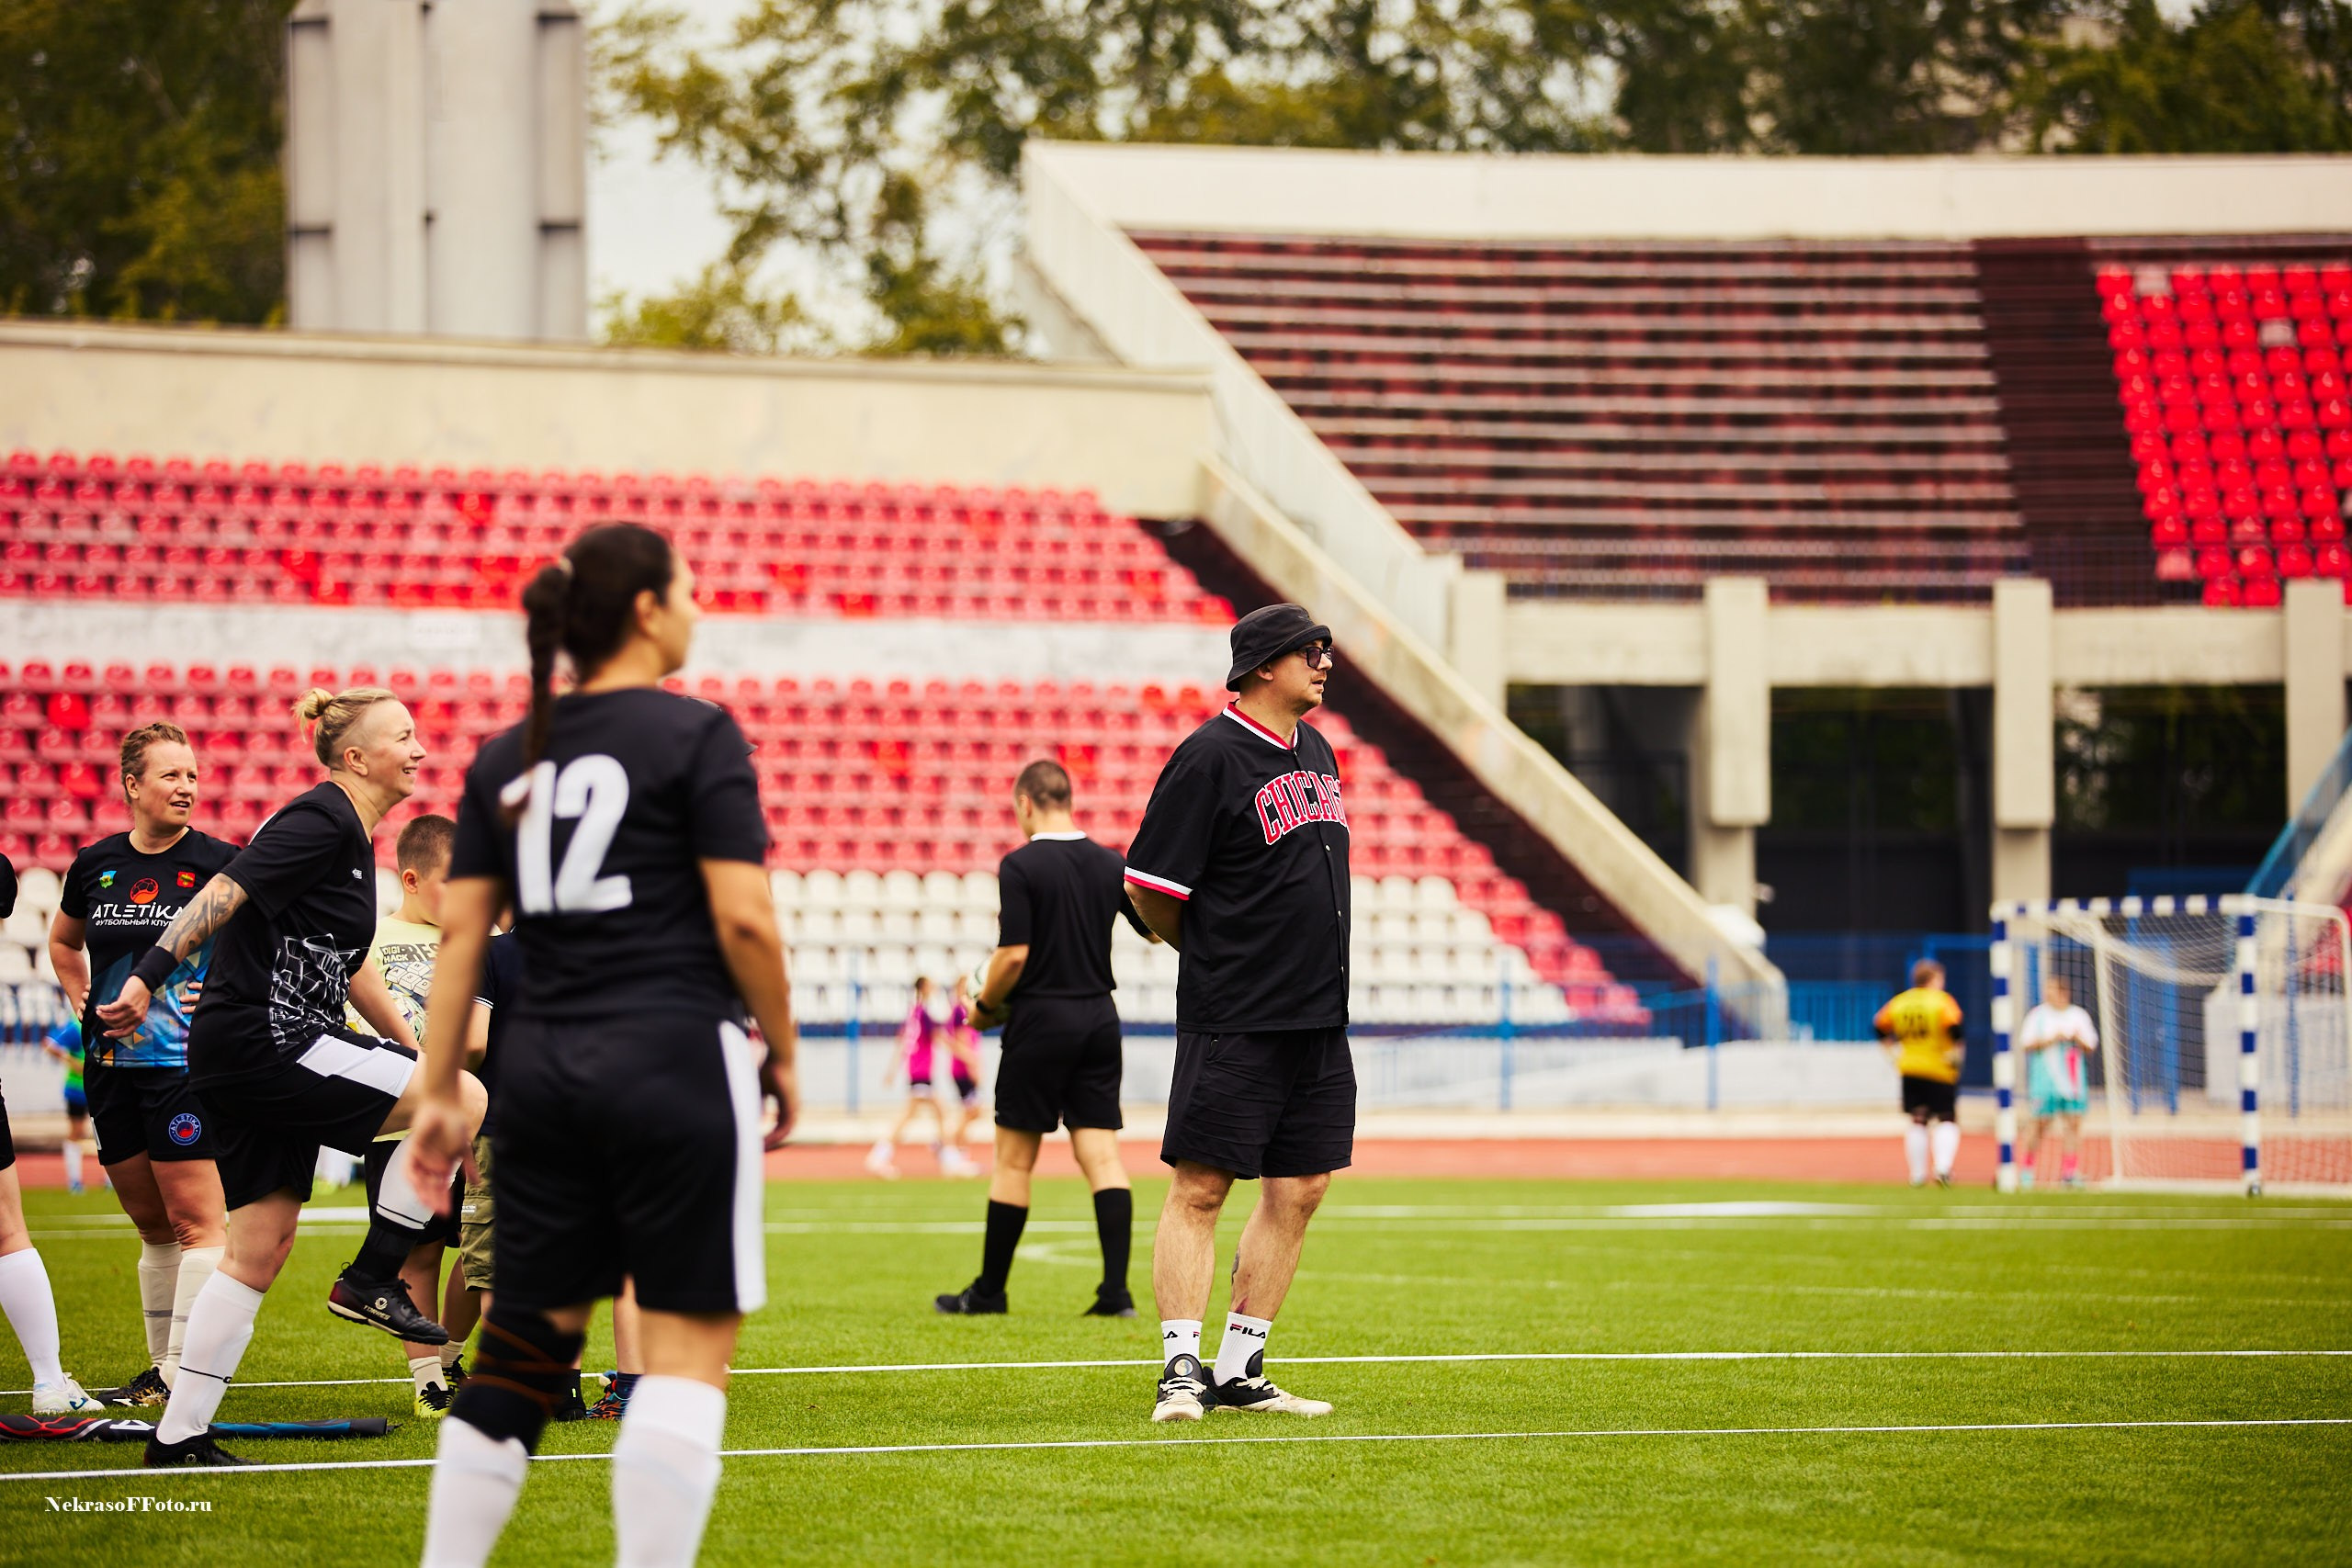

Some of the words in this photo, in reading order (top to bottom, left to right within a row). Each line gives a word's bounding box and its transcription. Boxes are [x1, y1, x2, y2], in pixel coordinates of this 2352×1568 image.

[1255, 770, 1350, 845] CHICAG
[500, 753, 633, 914] 12
[96, 919, 149, 927] ФУТБОЛЬНЫЙ
[1229, 1323, 1266, 1339] FILA
